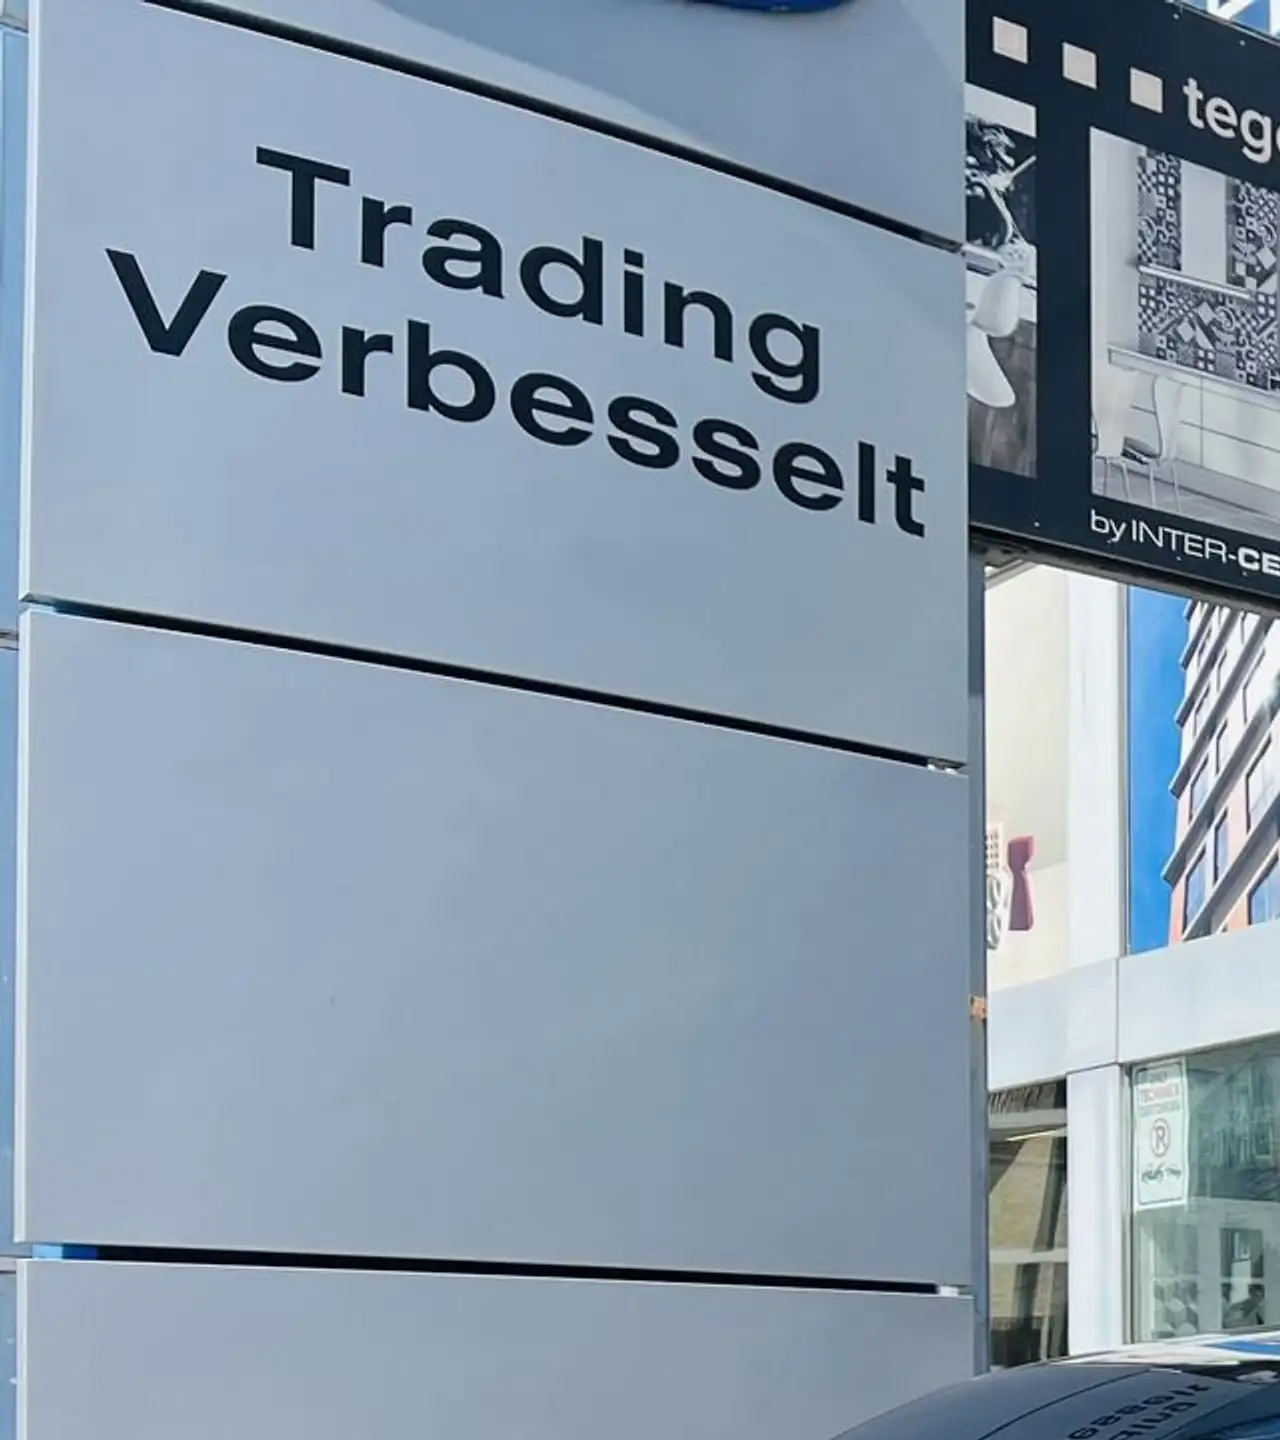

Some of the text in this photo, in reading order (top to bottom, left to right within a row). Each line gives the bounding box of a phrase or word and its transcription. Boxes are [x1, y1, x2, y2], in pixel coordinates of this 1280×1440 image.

[105, 248, 926, 538] Verbesselt
[256, 146, 820, 405] Trading
[1090, 509, 1127, 543] by
